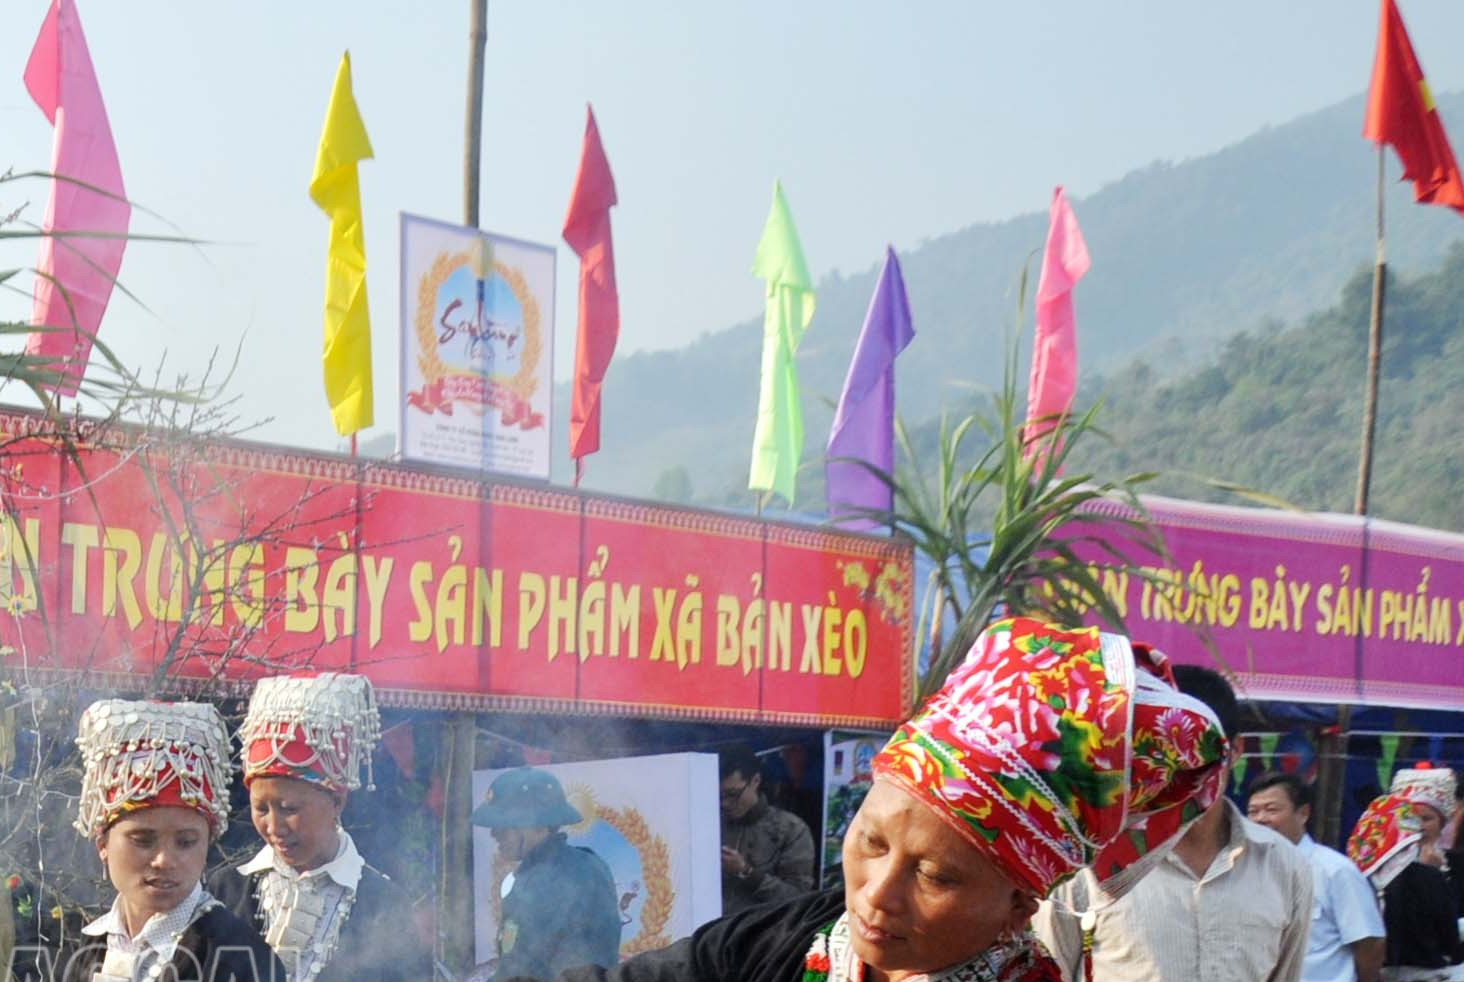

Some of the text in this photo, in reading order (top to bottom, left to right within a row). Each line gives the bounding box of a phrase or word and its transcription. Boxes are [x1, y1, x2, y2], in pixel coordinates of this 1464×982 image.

[62, 523, 264, 631] TRƯNG
[285, 530, 393, 649] BÀY
[409, 535, 503, 654] SẢN
[519, 545, 641, 664] PHẨM
[649, 574, 703, 671] XÃ
[716, 572, 792, 677] BẢN
[799, 590, 867, 678] XÈO
[1140, 560, 1241, 627] TRƯNG
[1249, 565, 1311, 632] BÀY
[1316, 565, 1373, 637] SẢN
[1379, 566, 1451, 646] PHẨM
